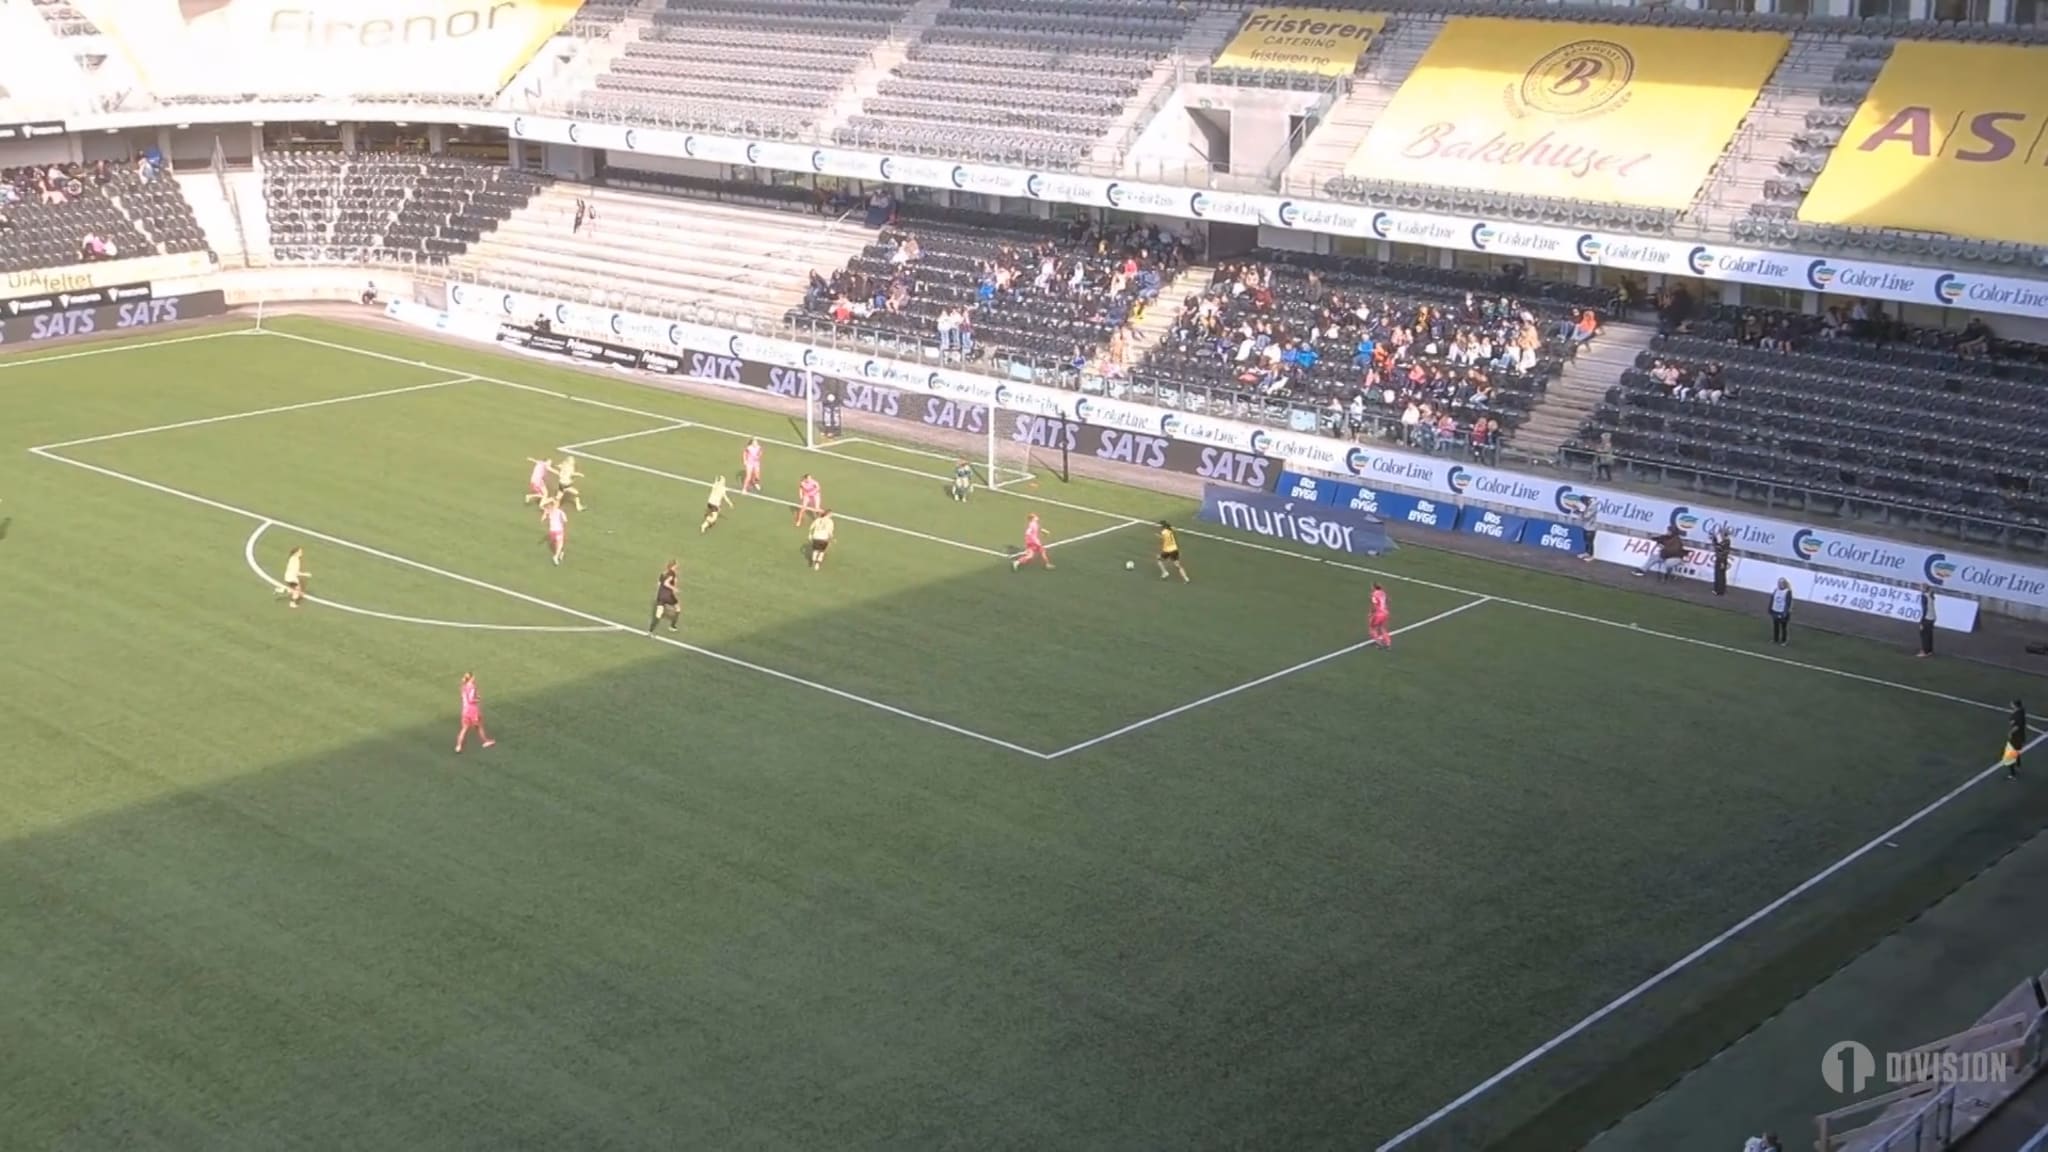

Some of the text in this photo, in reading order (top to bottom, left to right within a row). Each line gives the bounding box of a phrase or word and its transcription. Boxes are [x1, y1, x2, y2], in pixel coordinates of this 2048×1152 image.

[269, 1, 516, 46] Firenor
[1244, 14, 1373, 41] Fristeren
[1263, 35, 1336, 48] CATERING
[31, 308, 95, 340] SATS
[117, 298, 180, 328] SATS
[688, 353, 743, 383] SATS
[766, 367, 825, 401] SATS
[843, 381, 901, 417] SATS
[923, 396, 986, 433] SATS
[1012, 412, 1080, 450] SATS
[1096, 429, 1169, 469] SATS
[1196, 447, 1271, 488] SATS
[1350, 498, 1379, 513] BYGG
[1408, 509, 1437, 525] BYGG
[1217, 499, 1354, 552] murisør
[1474, 521, 1504, 537] BYGG
[1540, 533, 1573, 550] BYGG
[1850, 596, 1874, 610] 480
[1876, 601, 1894, 614] 22
[1897, 606, 1921, 620] 400
